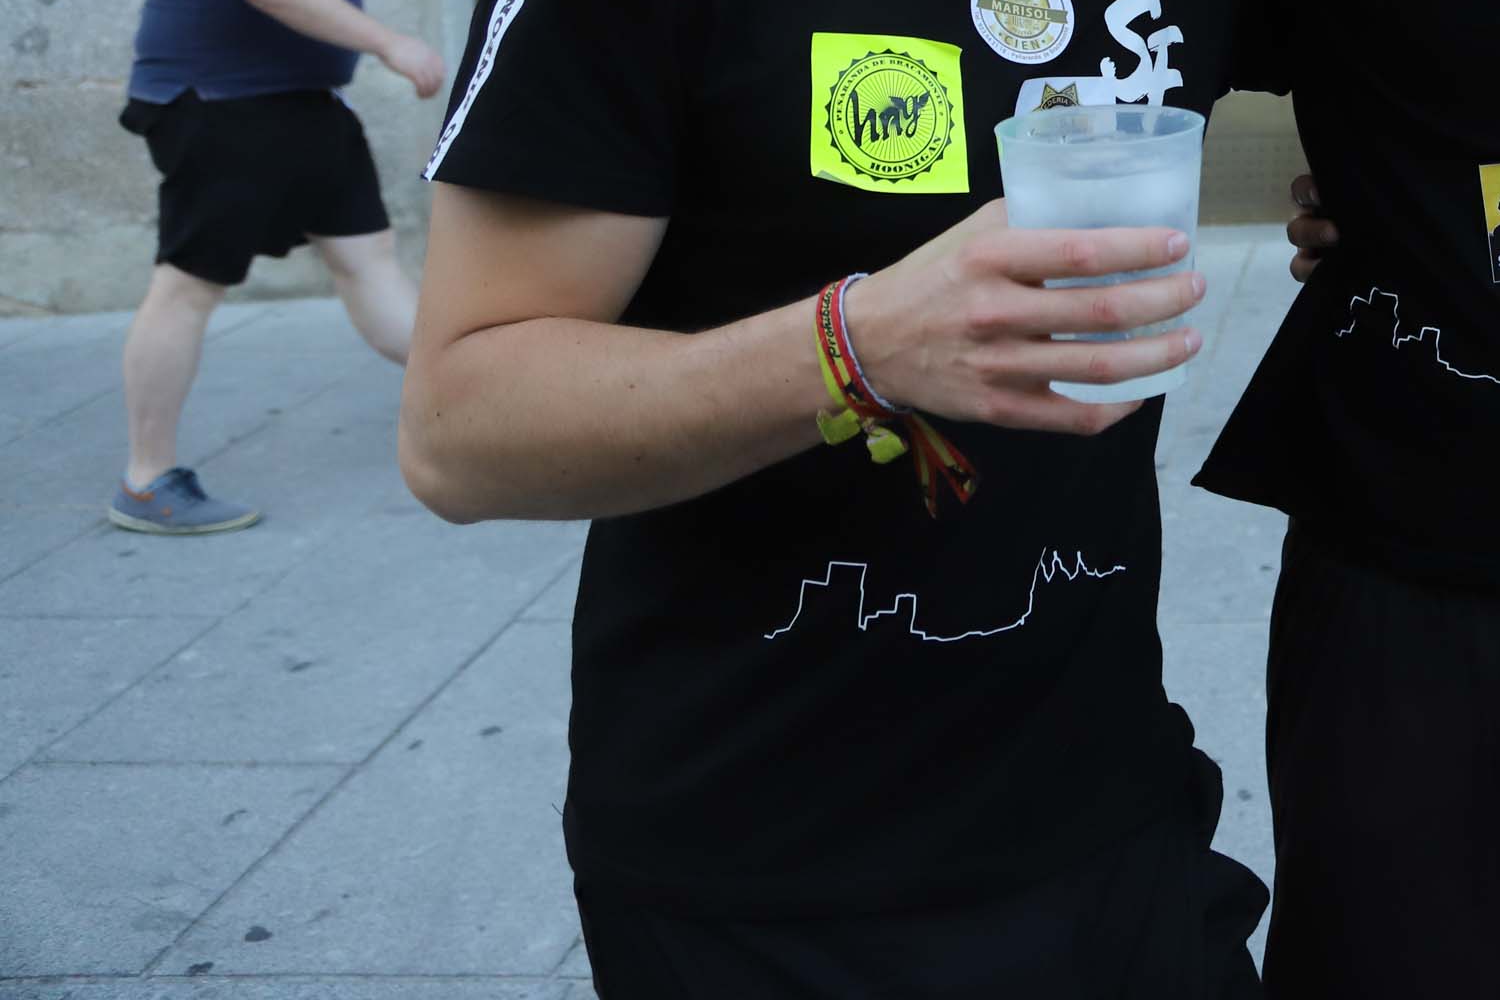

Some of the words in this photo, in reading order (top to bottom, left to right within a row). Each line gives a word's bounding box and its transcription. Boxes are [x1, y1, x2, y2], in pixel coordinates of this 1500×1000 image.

[991, 0, 1051, 20] MARISOL
[1004, 35, 1040, 50] CIEN
[890, 60, 943, 105] BRACAMONTE
[869, 135, 942, 173] HOONIGAN
